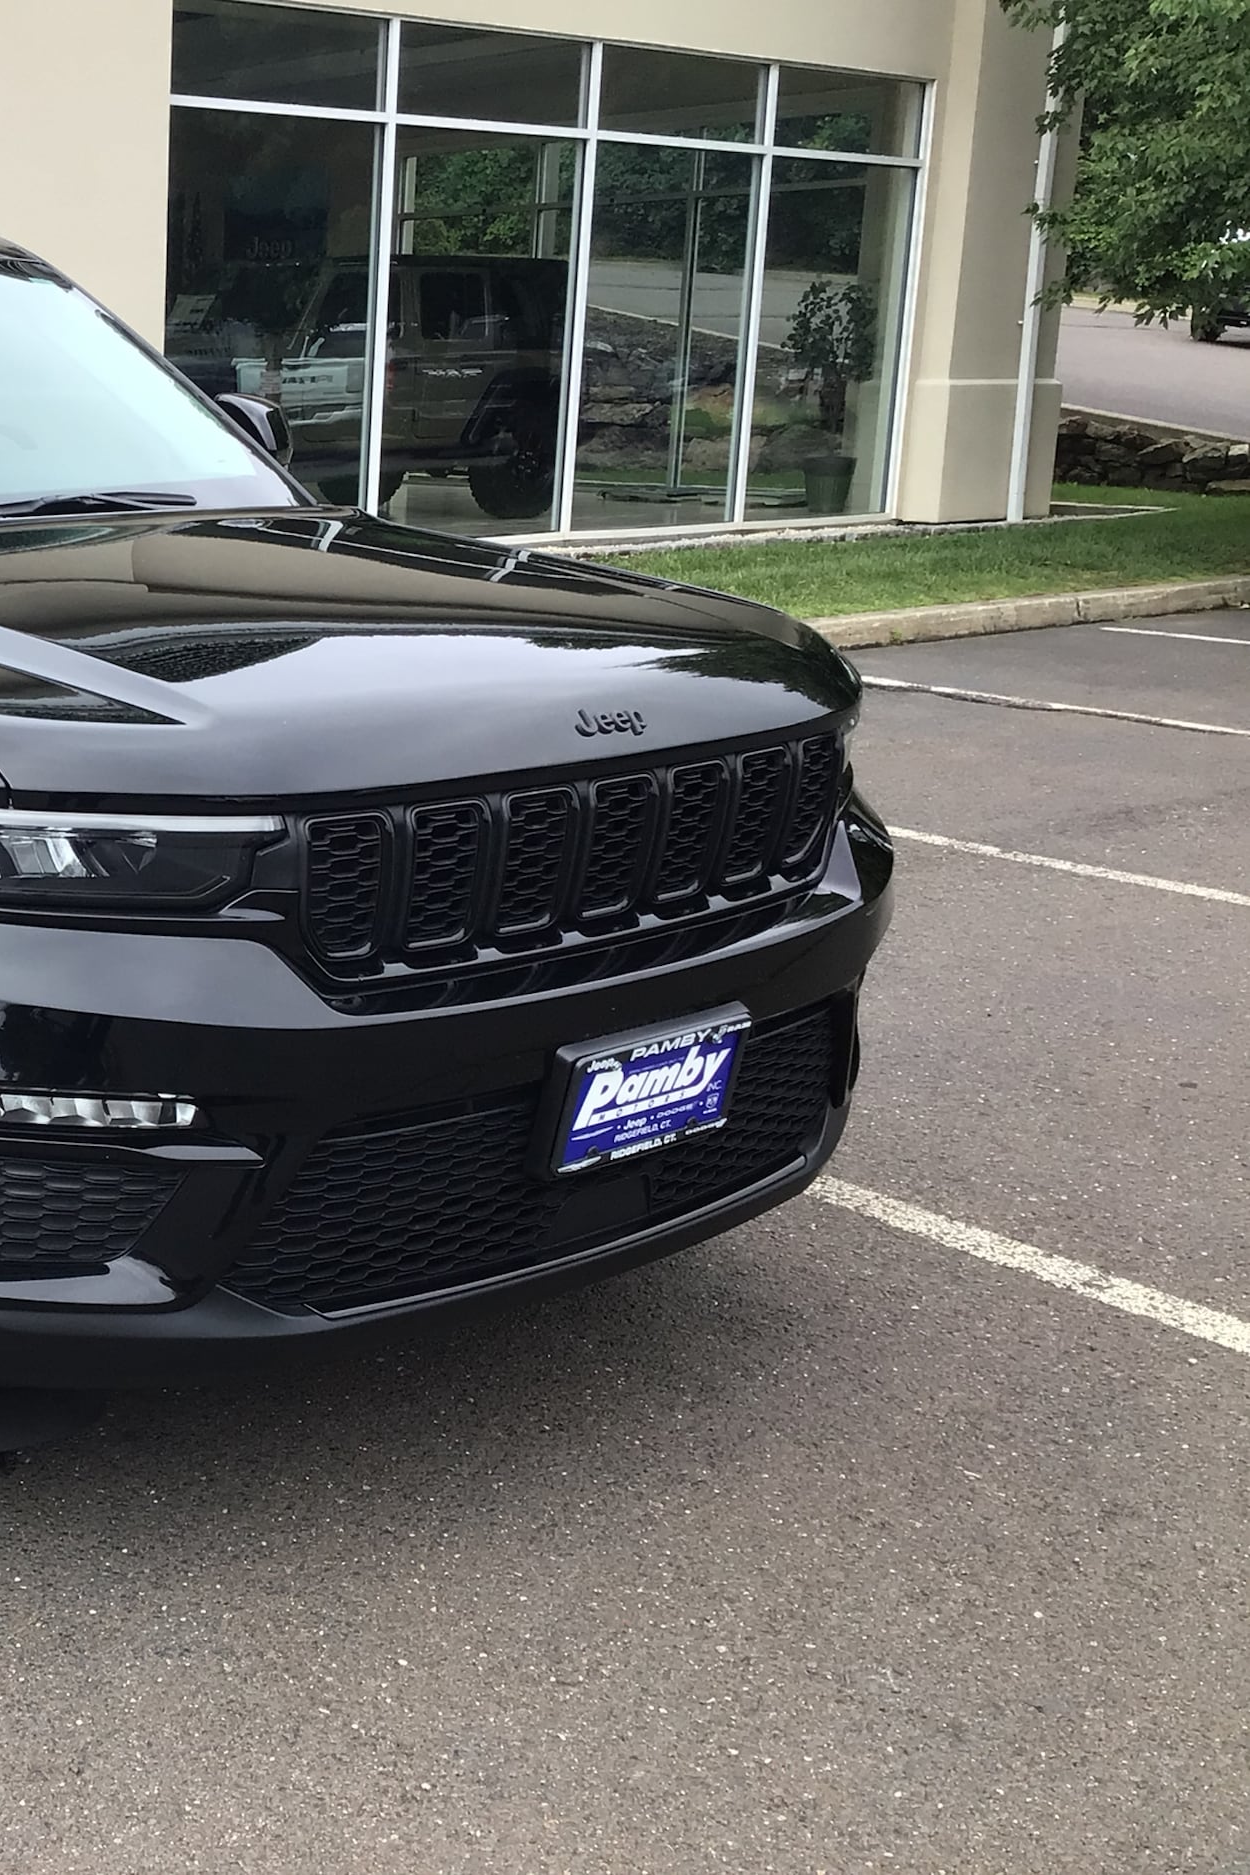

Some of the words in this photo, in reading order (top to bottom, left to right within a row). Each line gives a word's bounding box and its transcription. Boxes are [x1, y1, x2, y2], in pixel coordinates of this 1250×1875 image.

[575, 709, 647, 738] Jeep
[630, 1028, 712, 1062] PAMBY
[572, 1044, 732, 1131] Pamby
[623, 1117, 647, 1131] Jeep
[656, 1103, 694, 1119] DODGE
